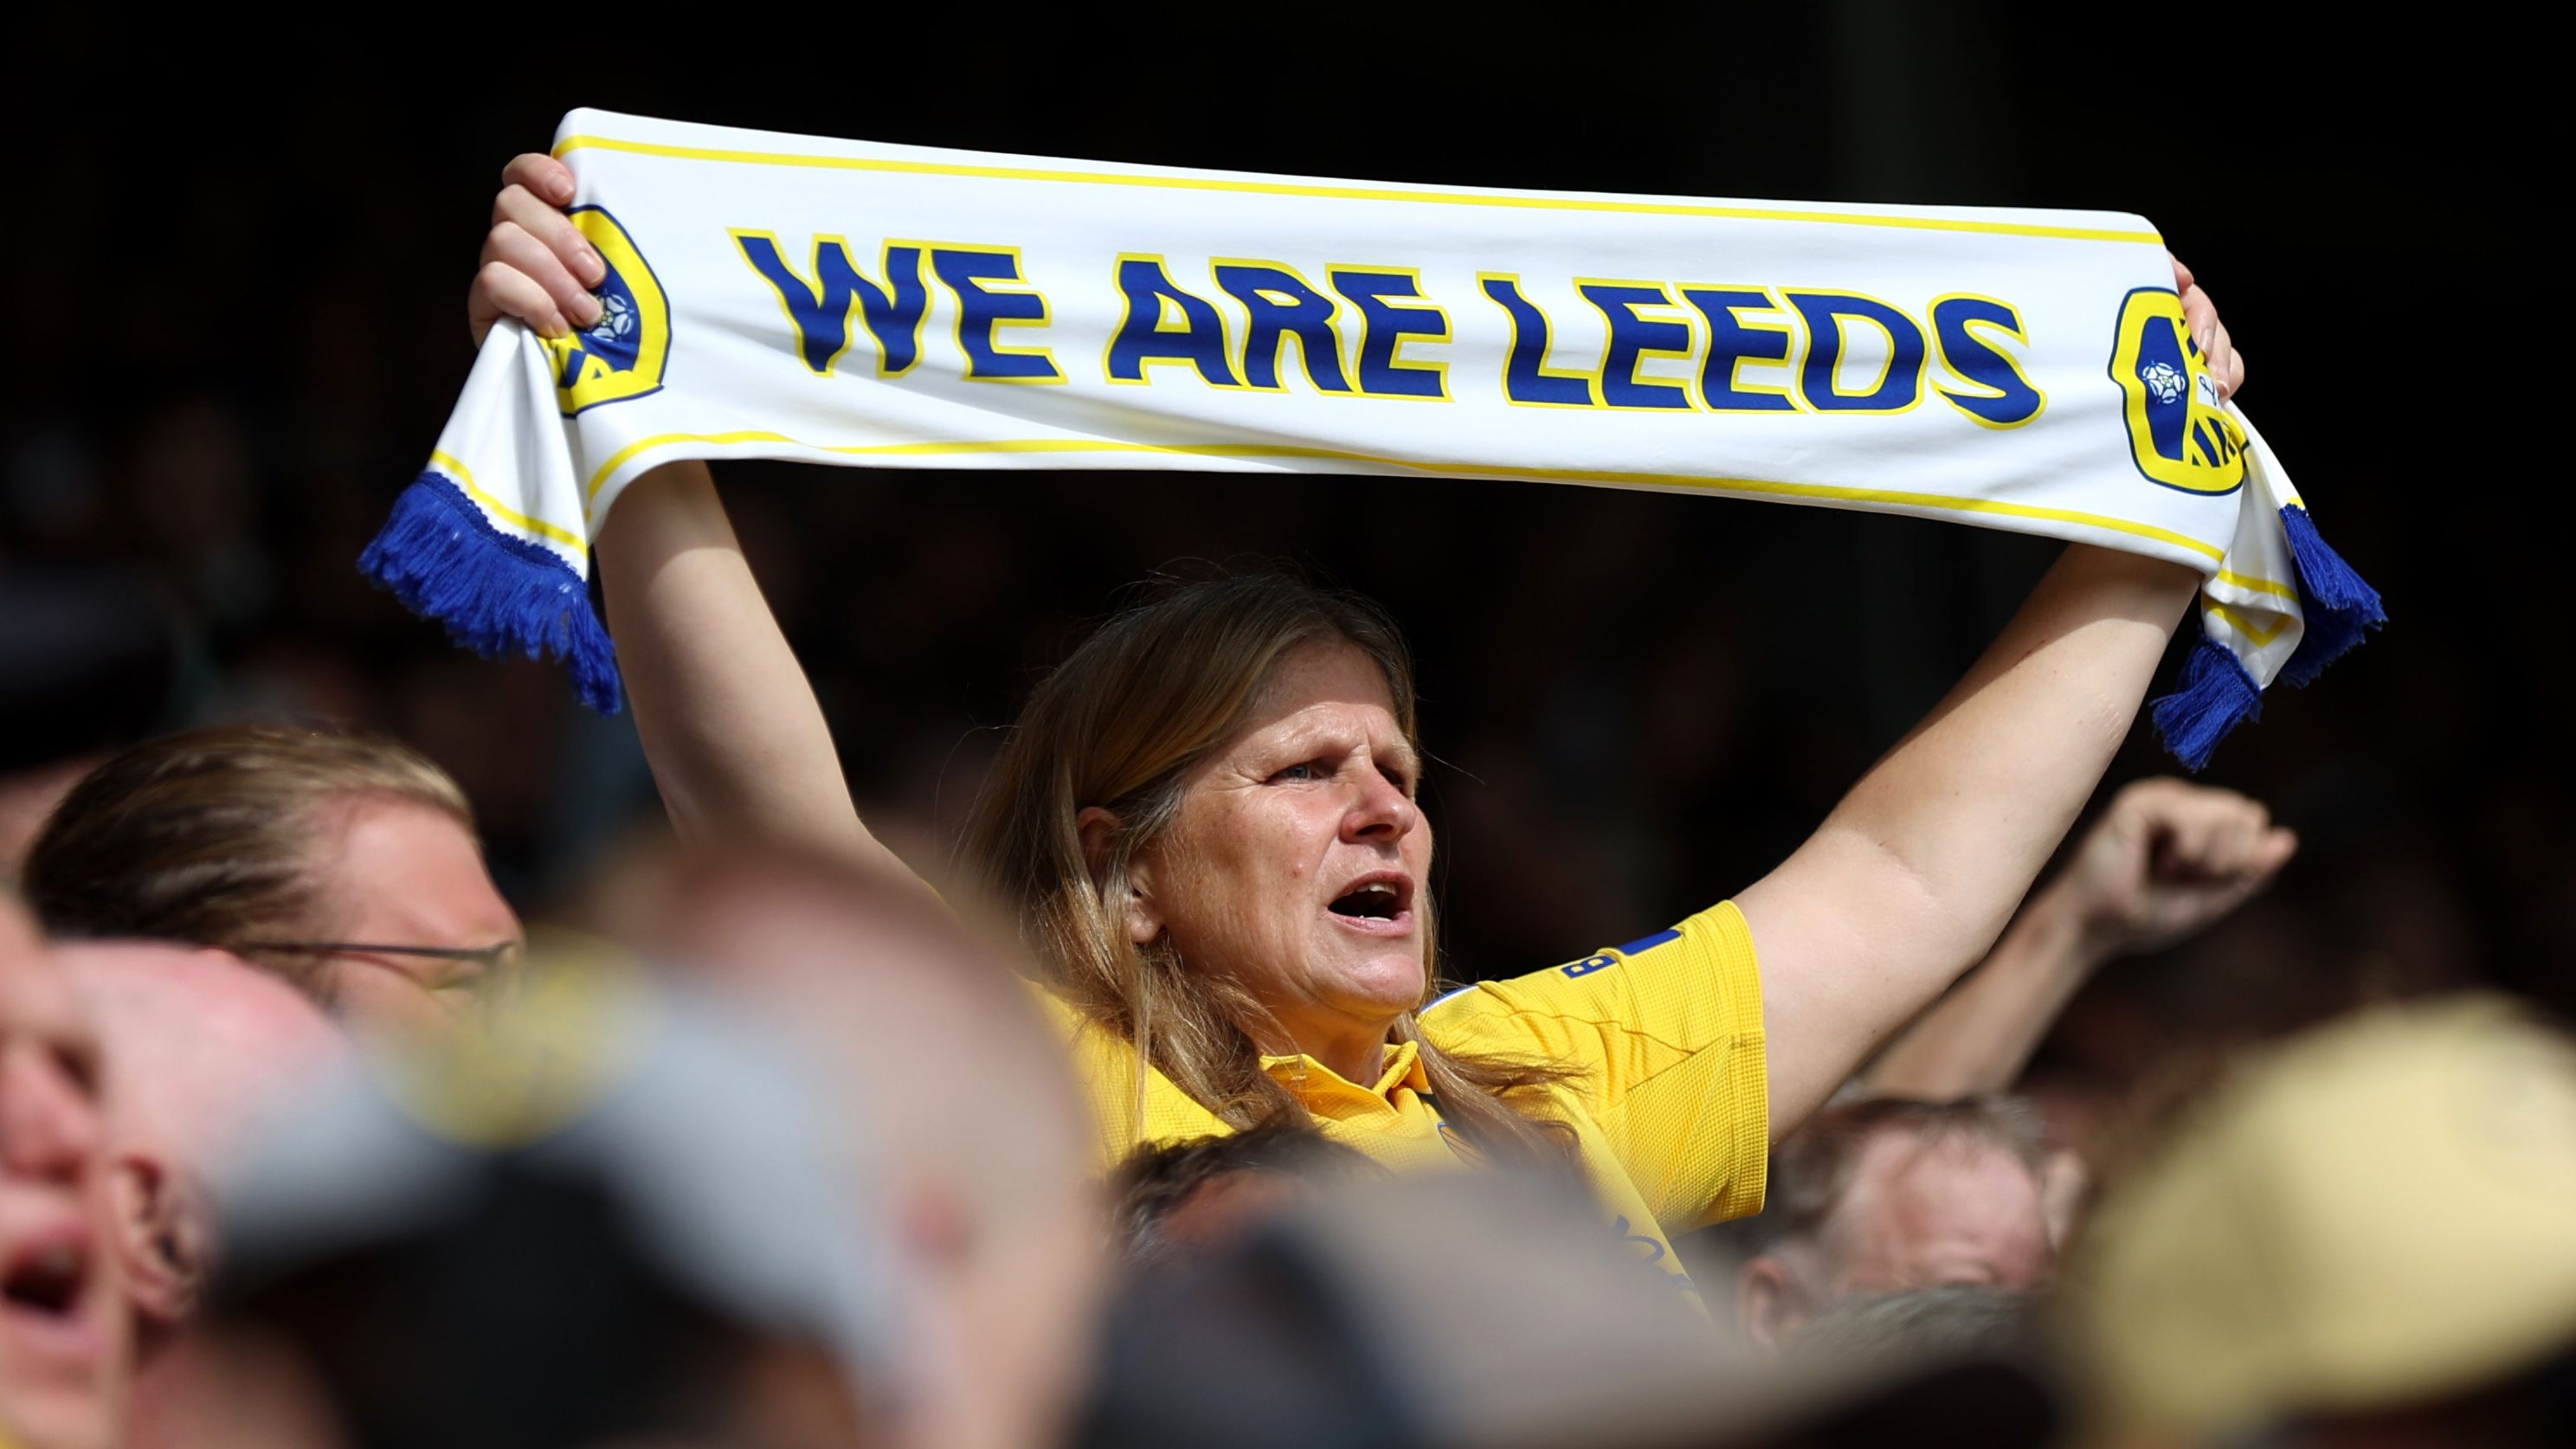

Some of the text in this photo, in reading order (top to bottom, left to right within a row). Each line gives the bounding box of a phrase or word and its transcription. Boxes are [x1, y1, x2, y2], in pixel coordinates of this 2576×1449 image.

[726, 227, 2048, 431] WE ARE LEEDS
